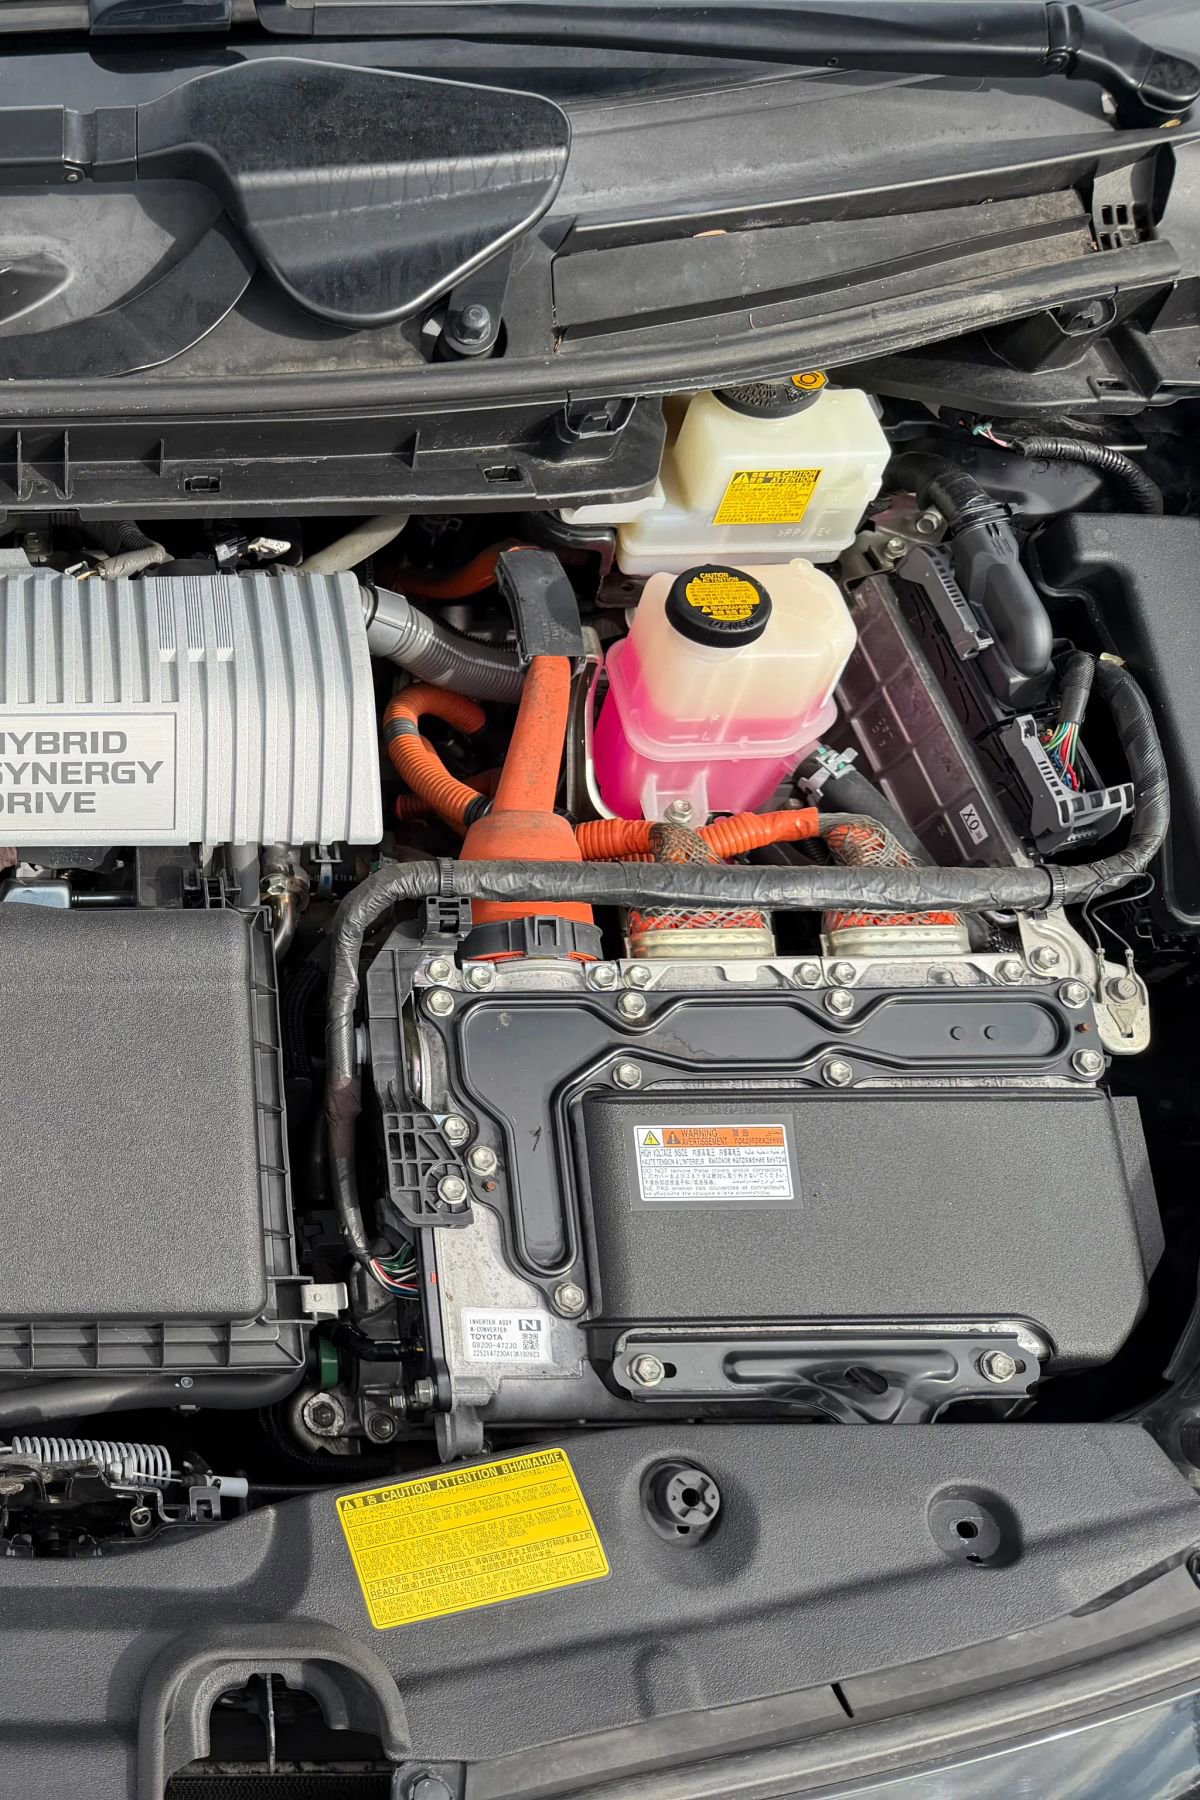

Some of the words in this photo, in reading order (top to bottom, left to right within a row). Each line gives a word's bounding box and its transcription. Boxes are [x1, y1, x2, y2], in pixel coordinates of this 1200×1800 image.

[699, 572, 729, 580] CAUTION
[682, 1137, 727, 1145] AVERTISSEMENT
[521, 1320, 539, 1331] N
[470, 1333, 503, 1341] TOYOTA
[500, 1452, 562, 1474] ВНИМАНИЕ
[380, 1482, 431, 1501] CAUTION
[434, 1466, 498, 1489] ATTENTION
[370, 1585, 401, 1598] READY
